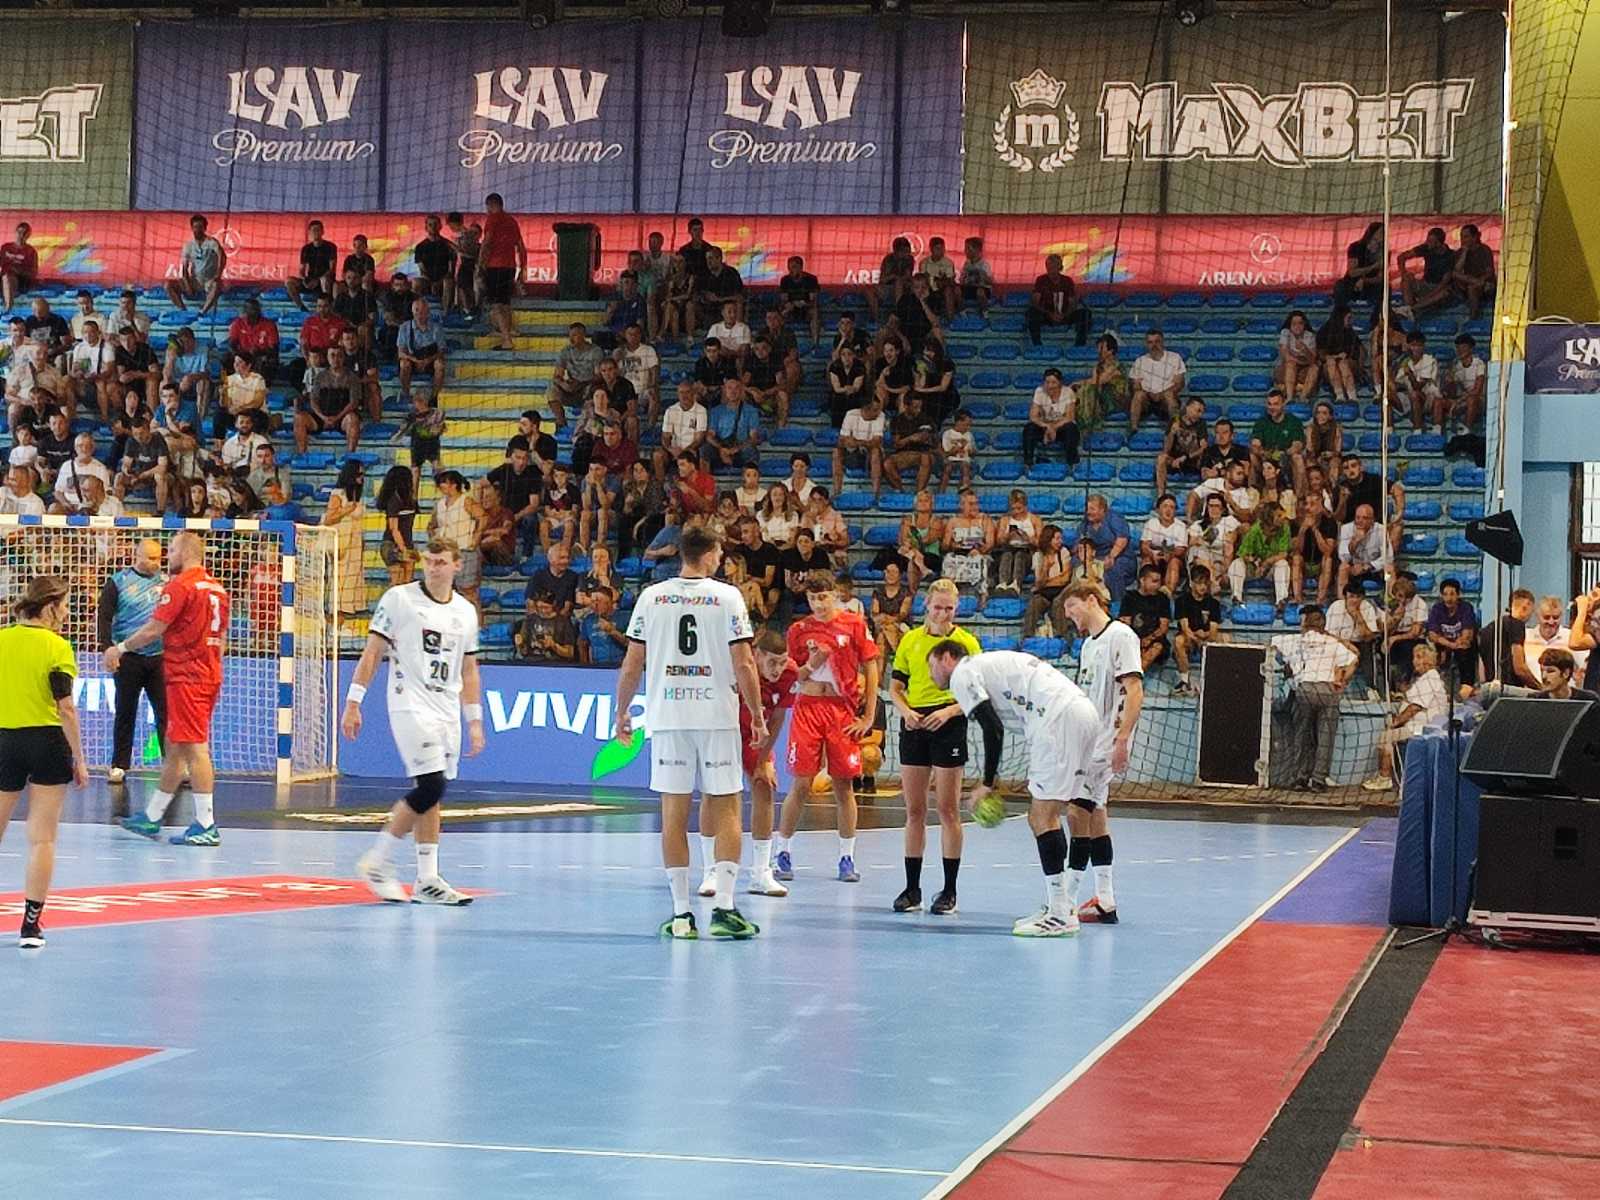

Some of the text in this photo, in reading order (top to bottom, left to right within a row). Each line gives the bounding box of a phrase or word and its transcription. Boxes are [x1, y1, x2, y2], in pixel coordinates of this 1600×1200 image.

[1096, 79, 1475, 169] MAXBET
[213, 128, 375, 168] Premium
[458, 129, 622, 168] Premium
[708, 129, 876, 169] Premium
[679, 614, 698, 656] 6
[430, 660, 449, 682] 20
[664, 687, 715, 700] HEITEC
